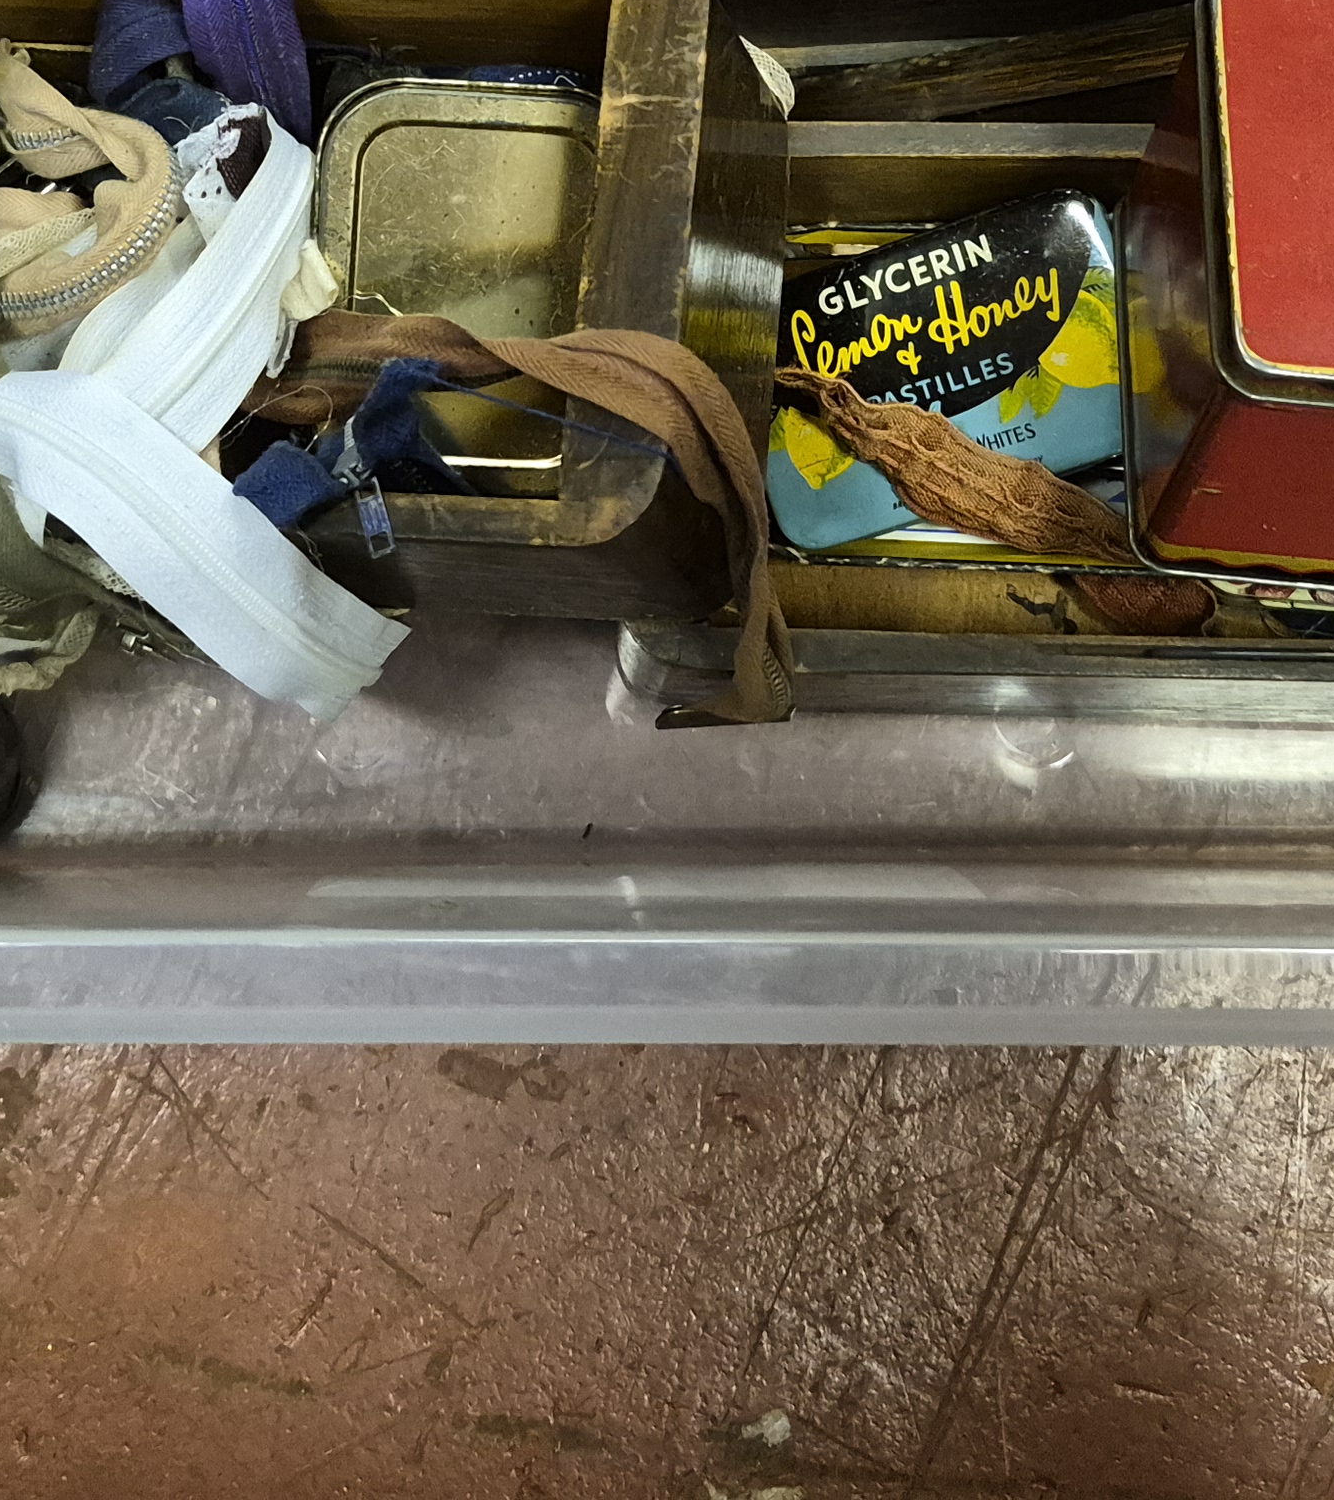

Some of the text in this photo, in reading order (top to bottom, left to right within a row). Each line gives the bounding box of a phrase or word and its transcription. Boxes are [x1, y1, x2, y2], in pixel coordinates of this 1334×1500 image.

[790, 309, 923, 379] Lemon
[927, 267, 1061, 355] Honey
[818, 233, 994, 316] GLYCERIN
